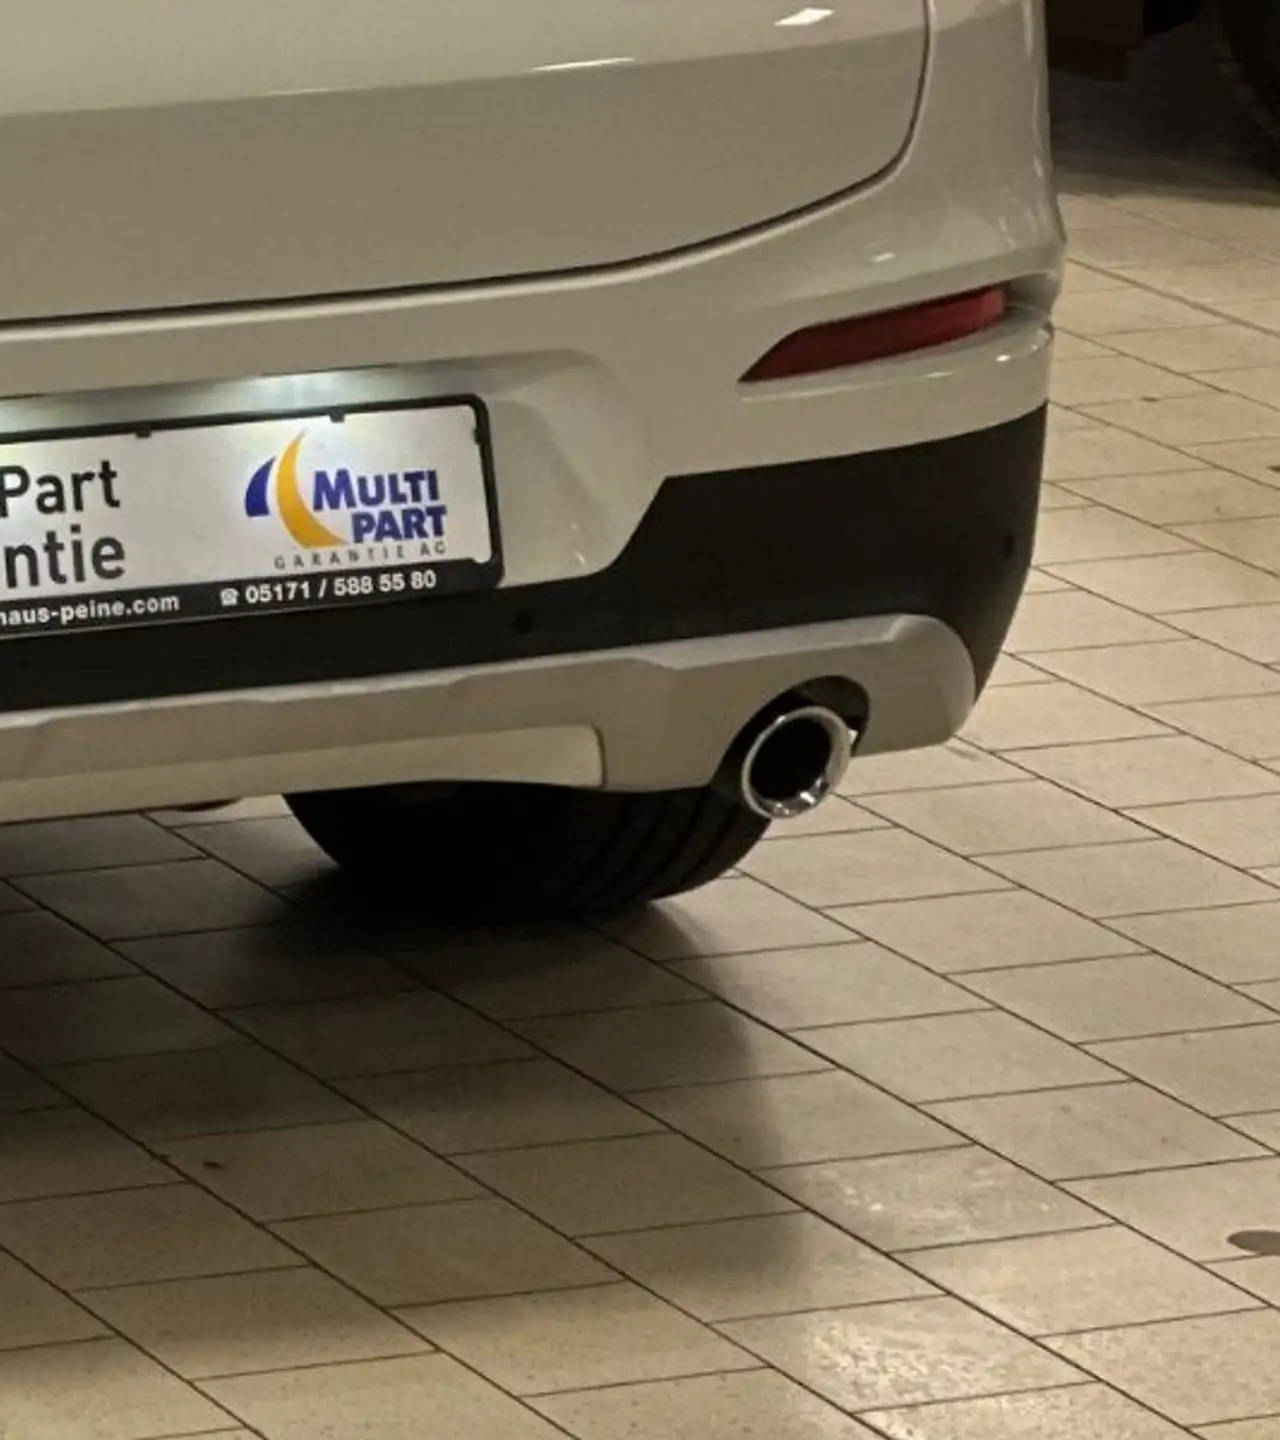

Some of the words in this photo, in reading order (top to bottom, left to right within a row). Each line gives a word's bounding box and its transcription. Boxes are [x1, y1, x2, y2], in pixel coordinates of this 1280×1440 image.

[351, 505, 447, 543] PART
[273, 546, 406, 570] GARANTIE
[244, 580, 311, 604] 05171
[334, 574, 374, 597] 588
[379, 571, 406, 593] 55
[410, 568, 437, 590] 80
